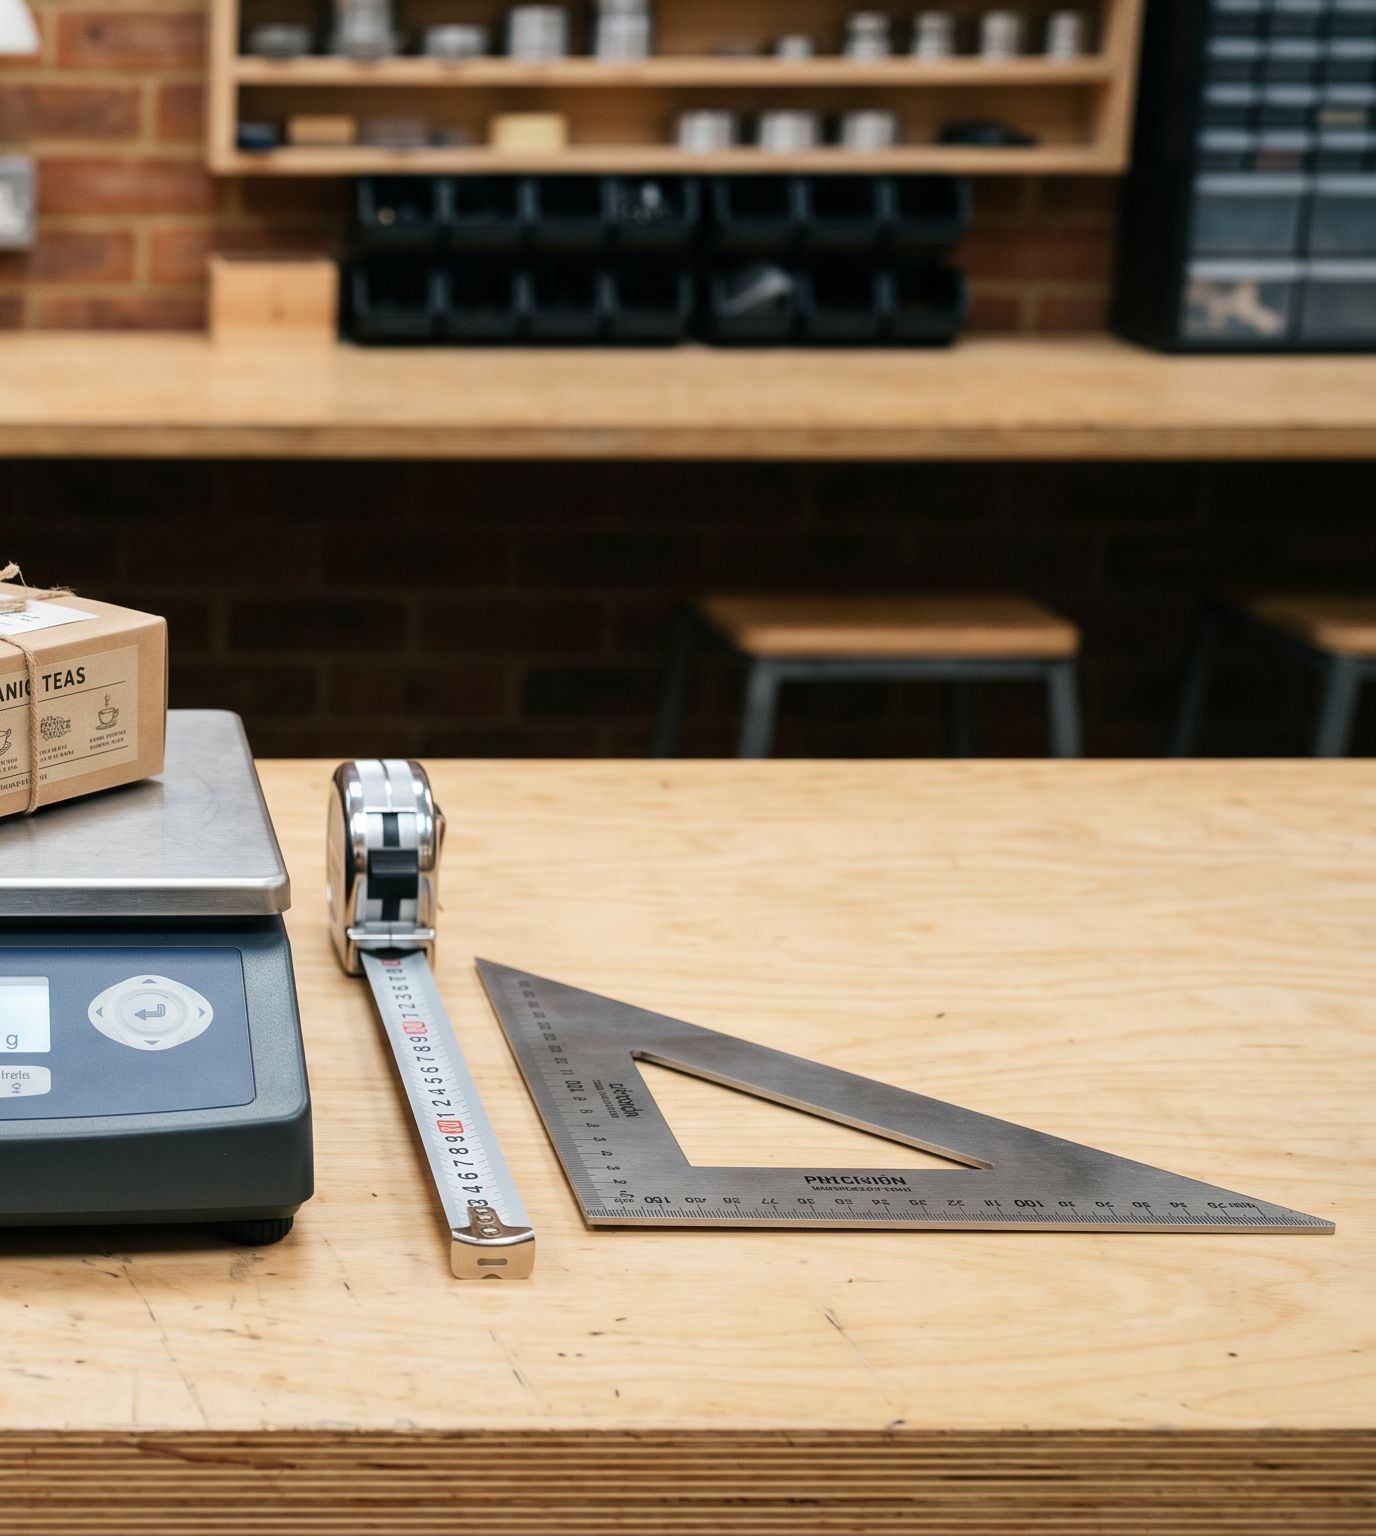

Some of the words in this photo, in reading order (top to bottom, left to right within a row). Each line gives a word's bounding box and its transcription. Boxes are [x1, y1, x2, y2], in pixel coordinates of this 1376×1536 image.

[42, 667, 86, 692] TEAS
[6, 1033, 18, 1050] g
[448, 1147, 469, 1155] 8
[457, 1172, 478, 1180] 6
[462, 1185, 483, 1193] 4
[1014, 1199, 1044, 1207] 100
